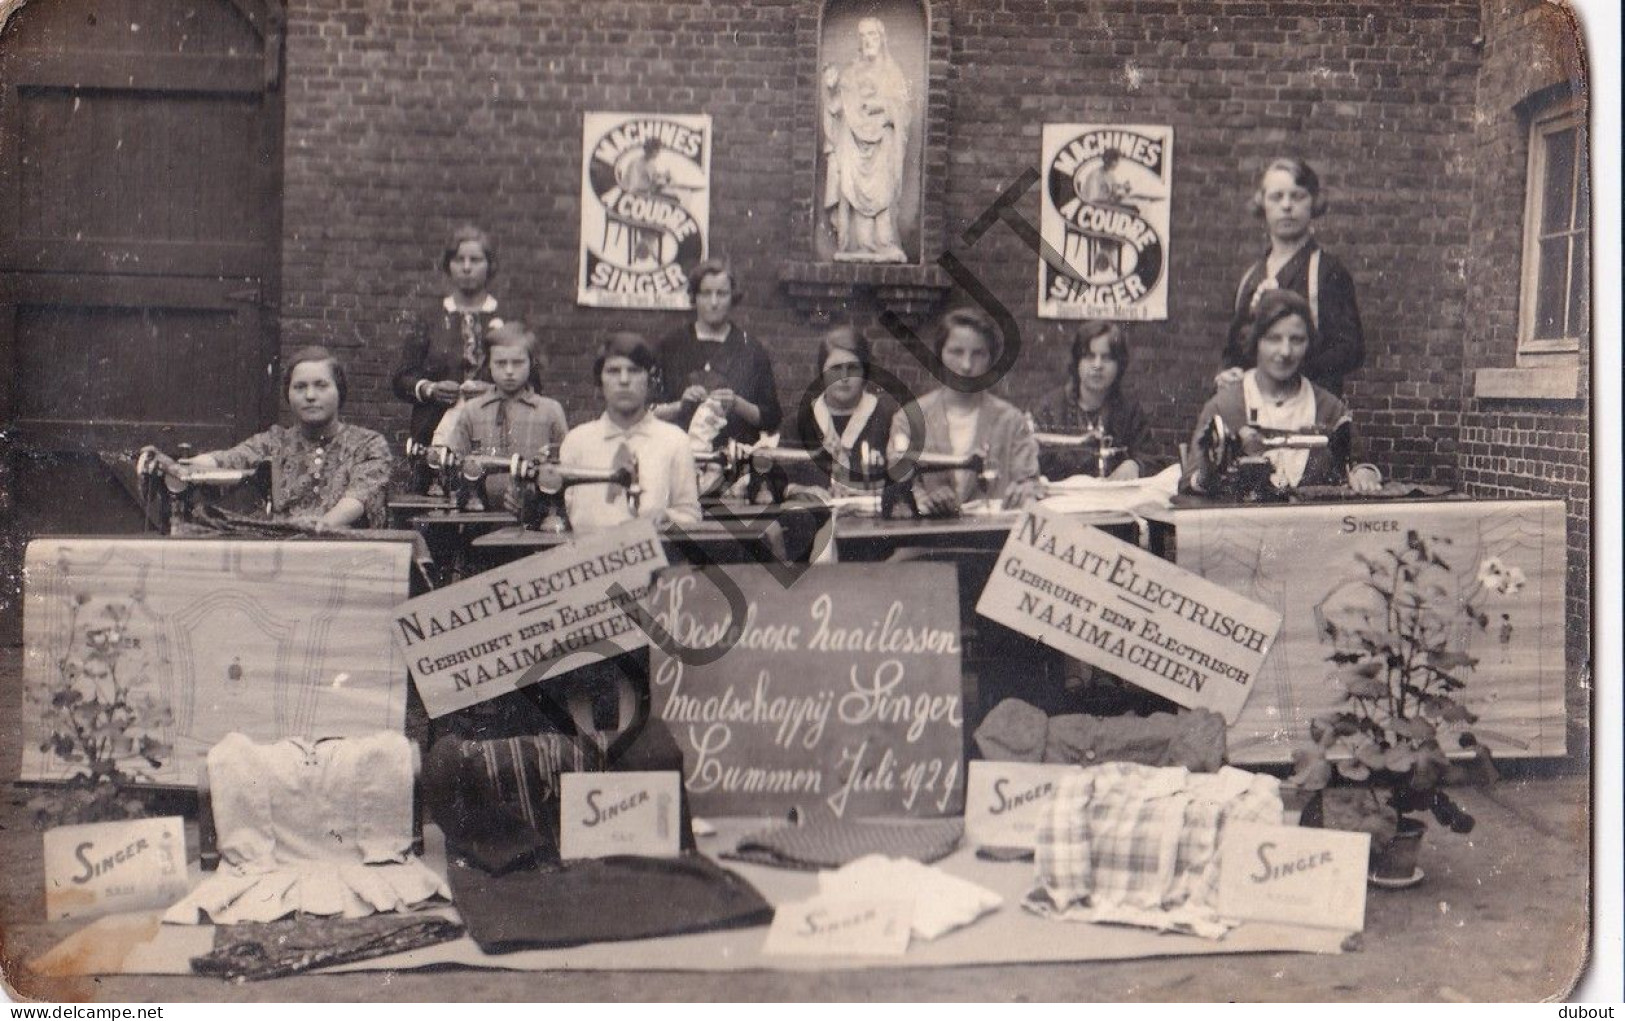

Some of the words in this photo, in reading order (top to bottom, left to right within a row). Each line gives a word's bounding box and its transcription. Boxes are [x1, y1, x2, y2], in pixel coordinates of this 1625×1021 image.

[594, 120, 701, 166] MACHINES
[1053, 131, 1162, 177] MACHINES
[618, 193, 698, 242] COUDRE
[1078, 207, 1158, 252] COUDRE
[590, 261, 689, 295] SINGER
[1050, 274, 1148, 306] SINGER
[1341, 515, 1400, 534] SINGER
[395, 597, 493, 647] NAAIT
[490, 539, 659, 612] ELECTRISCH
[1016, 512, 1110, 577] NAAIT
[1107, 554, 1269, 654] ELECTRISCH
[1003, 556, 1098, 614] GEBRUIKT
[1099, 607, 1137, 632] EEN
[1138, 617, 1251, 686] ELECTRISCH
[1016, 591, 1210, 694] NAAIMACHIEN
[417, 633, 513, 677] GEBRUIKT
[518, 620, 556, 640] EEN
[452, 609, 645, 692] NAAIMACHIEN
[838, 660, 964, 743] Singer
[684, 722, 822, 794] Lummen
[827, 741, 896, 818] Juli
[902, 758, 959, 814] 1929
[582, 789, 650, 827] SINGER
[988, 779, 1056, 815] SINGER
[71, 837, 150, 884] SINGER
[1250, 842, 1334, 883] SINGER
